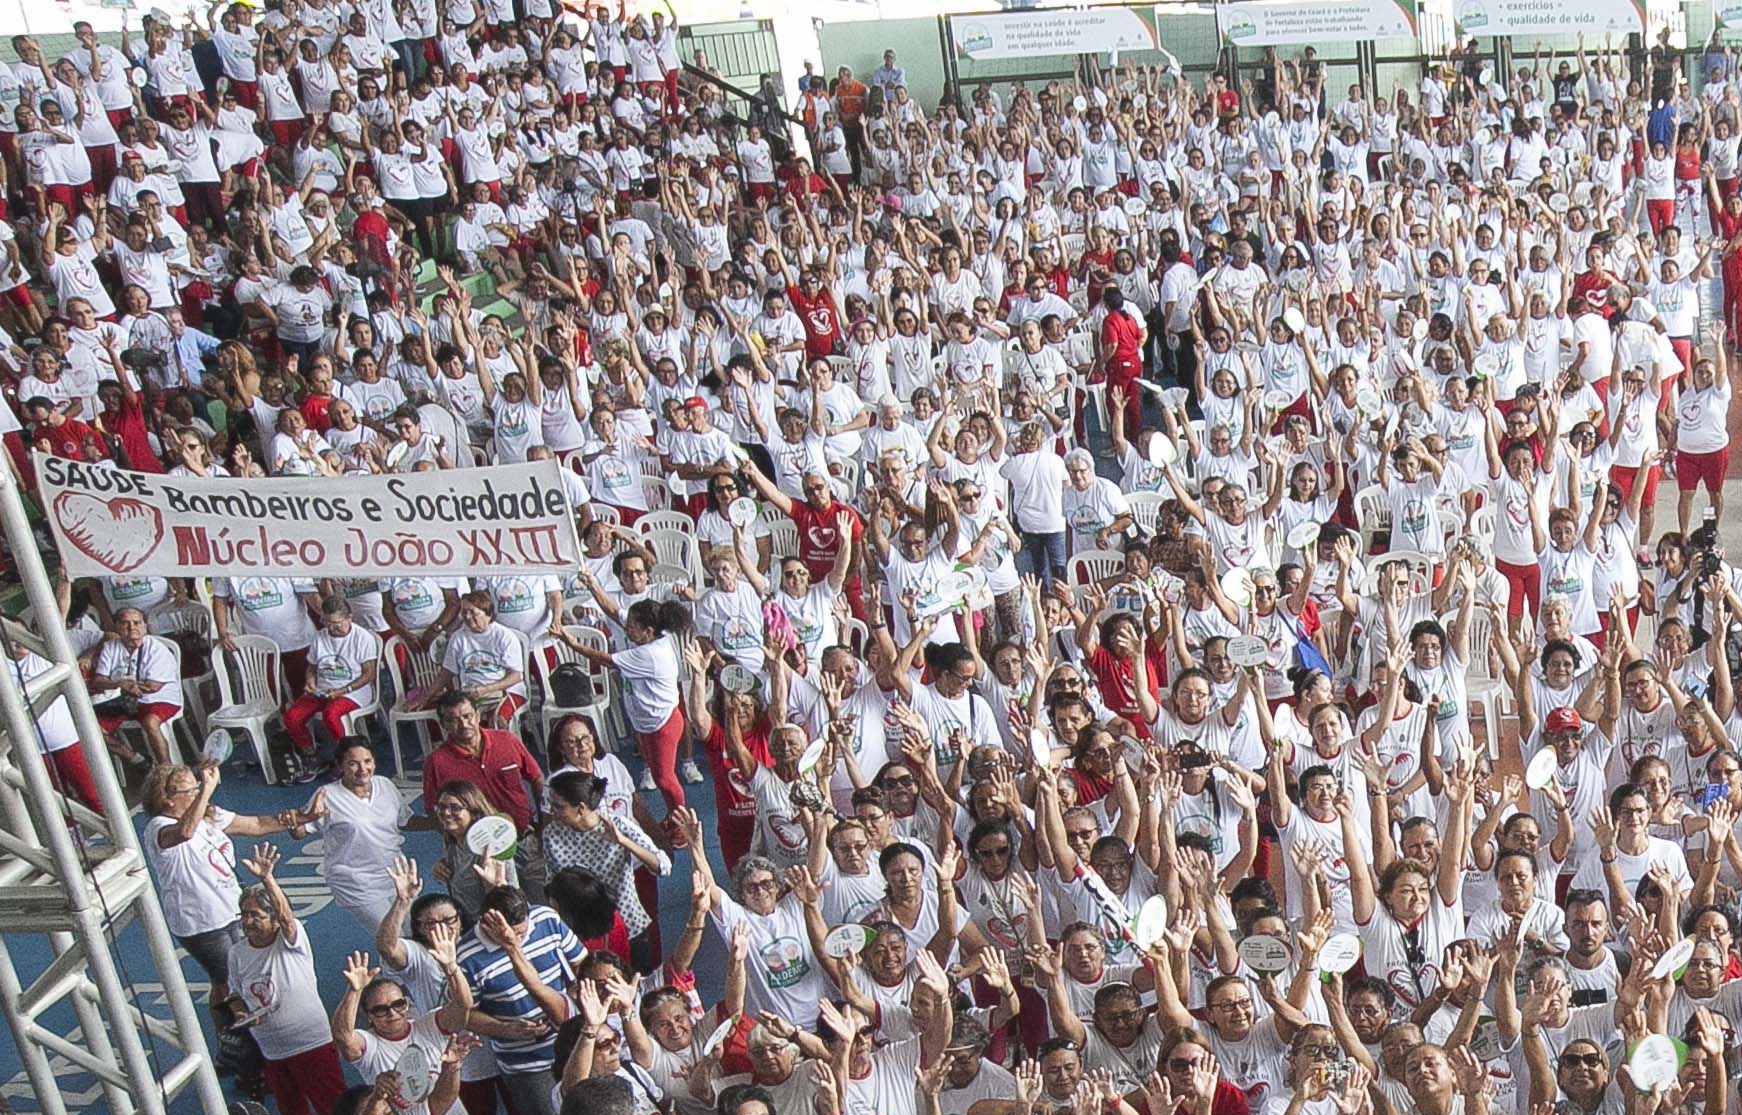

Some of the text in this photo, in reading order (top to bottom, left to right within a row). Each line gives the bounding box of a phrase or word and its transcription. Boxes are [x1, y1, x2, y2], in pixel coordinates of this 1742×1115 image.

[1507, 12, 1595, 27] qualidade de vida
[44, 457, 154, 496] SAÚDE
[361, 496, 382, 522] e
[387, 476, 565, 522] Sociedade
[172, 524, 578, 567] Núcleo João XXIII
